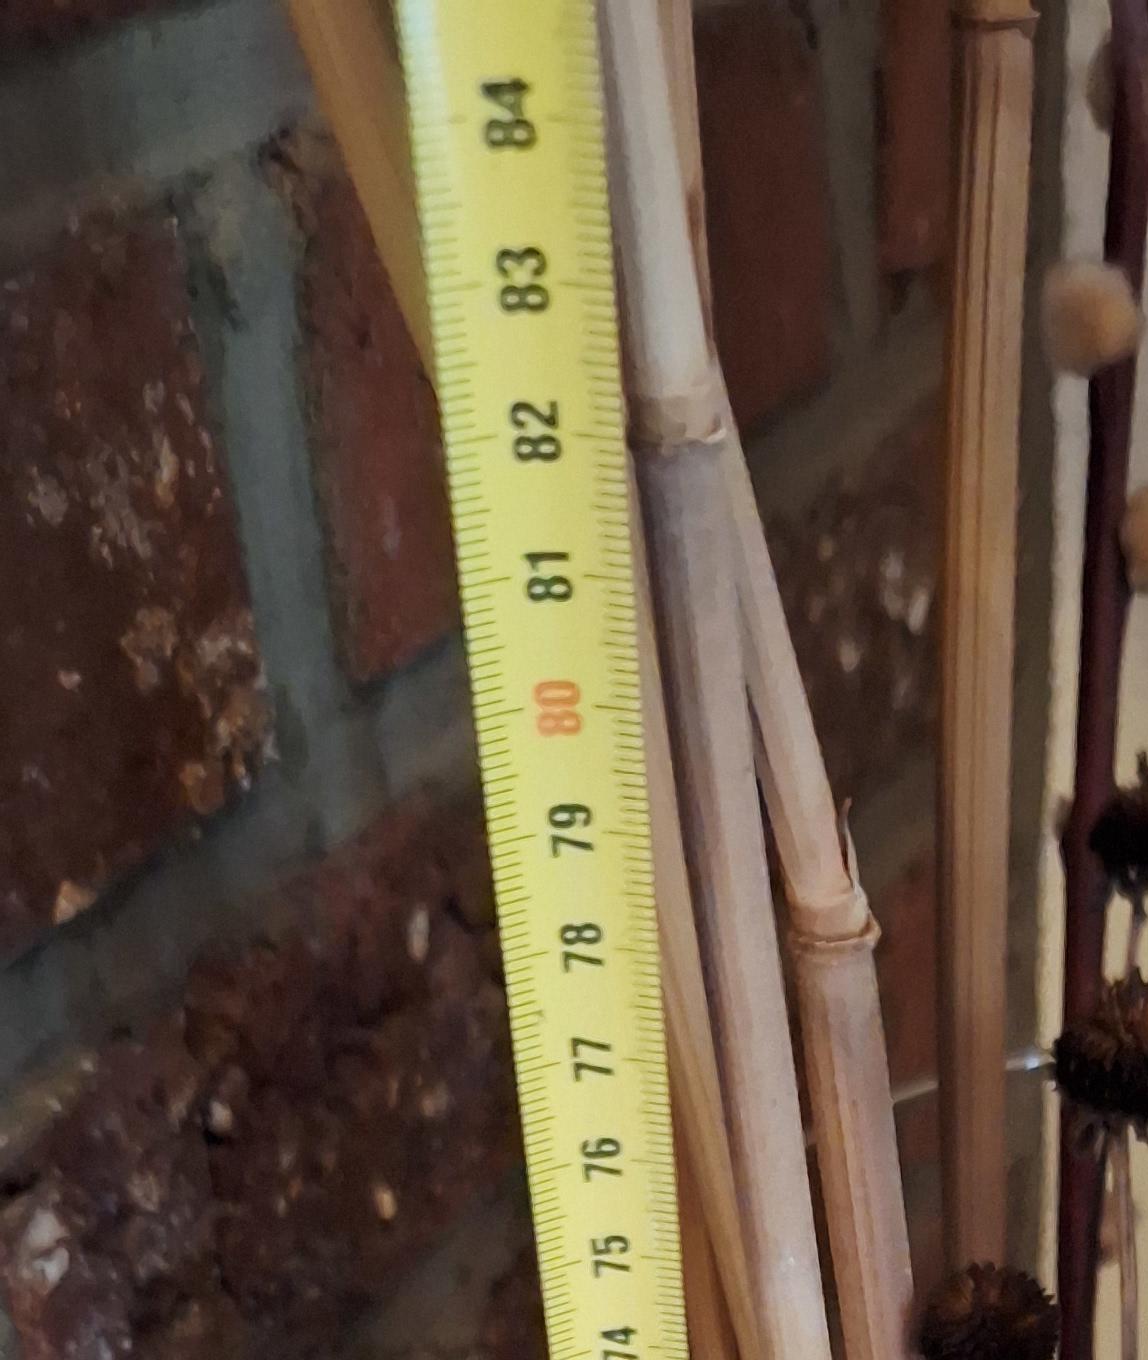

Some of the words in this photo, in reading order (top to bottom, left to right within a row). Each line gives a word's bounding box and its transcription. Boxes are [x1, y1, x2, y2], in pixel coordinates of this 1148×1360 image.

[481, 77, 537, 150] 84
[495, 246, 550, 313] 83
[510, 401, 562, 462] 82
[524, 551, 574, 603] 81
[533, 679, 583, 737] 80
[548, 803, 594, 857] 79
[559, 922, 604, 973] 78
[570, 1037, 614, 1082] 77
[580, 1137, 622, 1181] 76
[591, 1235, 631, 1278] 75
